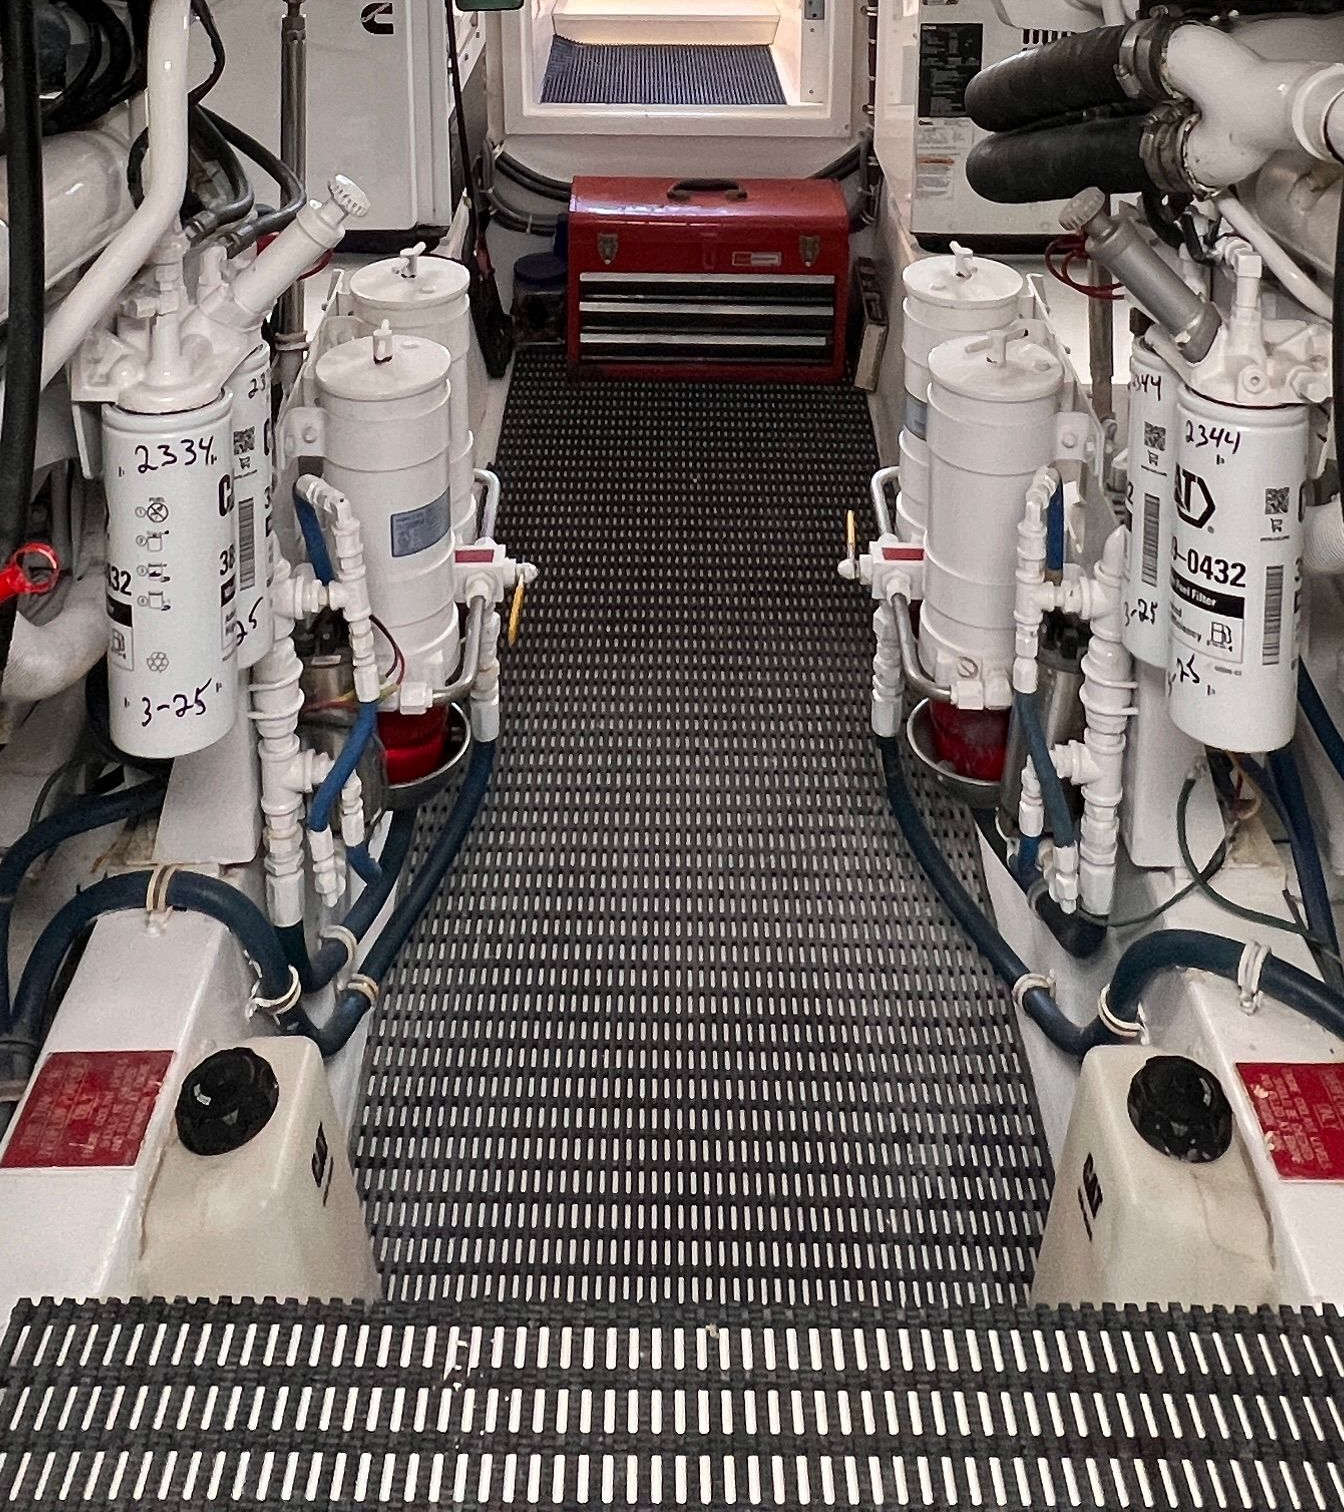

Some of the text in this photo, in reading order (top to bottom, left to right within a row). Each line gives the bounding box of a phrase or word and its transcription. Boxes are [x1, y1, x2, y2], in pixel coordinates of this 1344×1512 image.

[134, 435, 214, 474] 2334
[1185, 419, 1241, 454] 2344
[1191, 589, 1217, 607] Filter
[141, 678, 213, 727] 3-25
